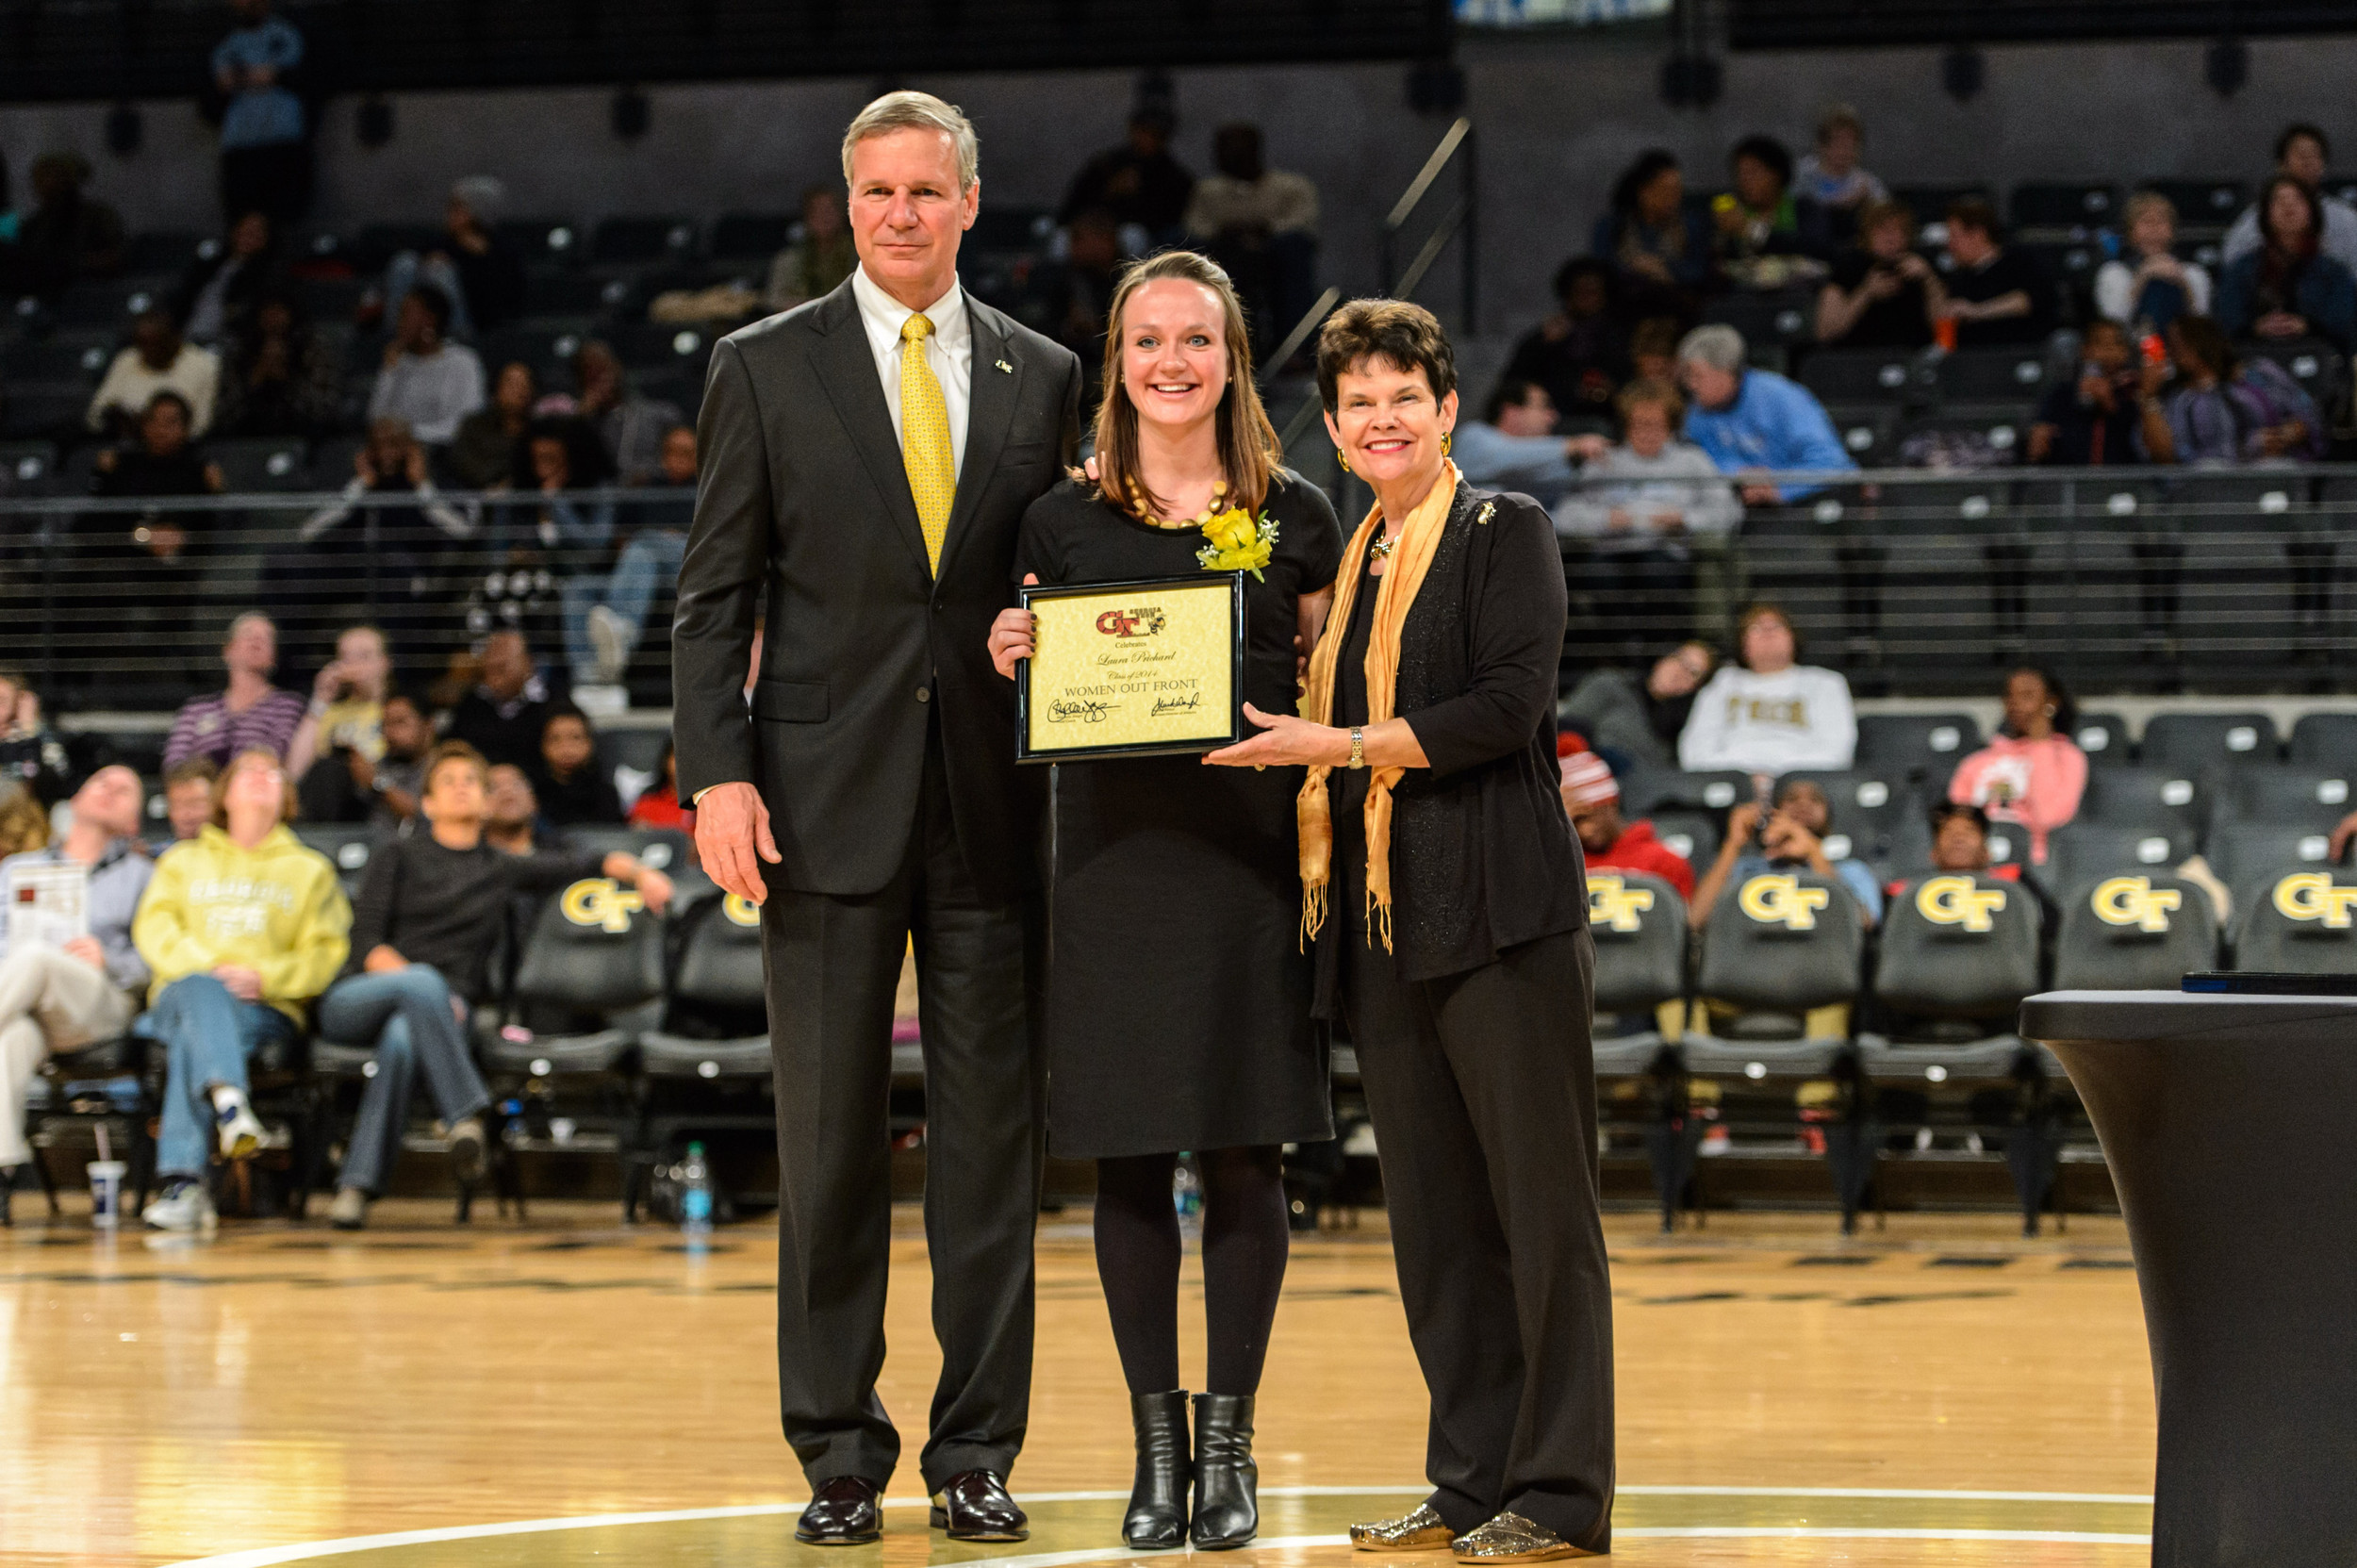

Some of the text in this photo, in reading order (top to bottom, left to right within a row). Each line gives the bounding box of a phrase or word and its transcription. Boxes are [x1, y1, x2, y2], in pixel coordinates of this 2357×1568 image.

[1096, 651, 1177, 666] Laura Prichard
[1107, 670, 1126, 679] Class
[1135, 670, 1158, 679] 2014
[1064, 678, 1198, 697] WOMEN OUT FRONT
[560, 878, 645, 933] GT
[1739, 874, 1829, 931] GT
[1916, 876, 2006, 932] GT
[2091, 876, 2182, 933] GT
[2272, 872, 2357, 929] GT
